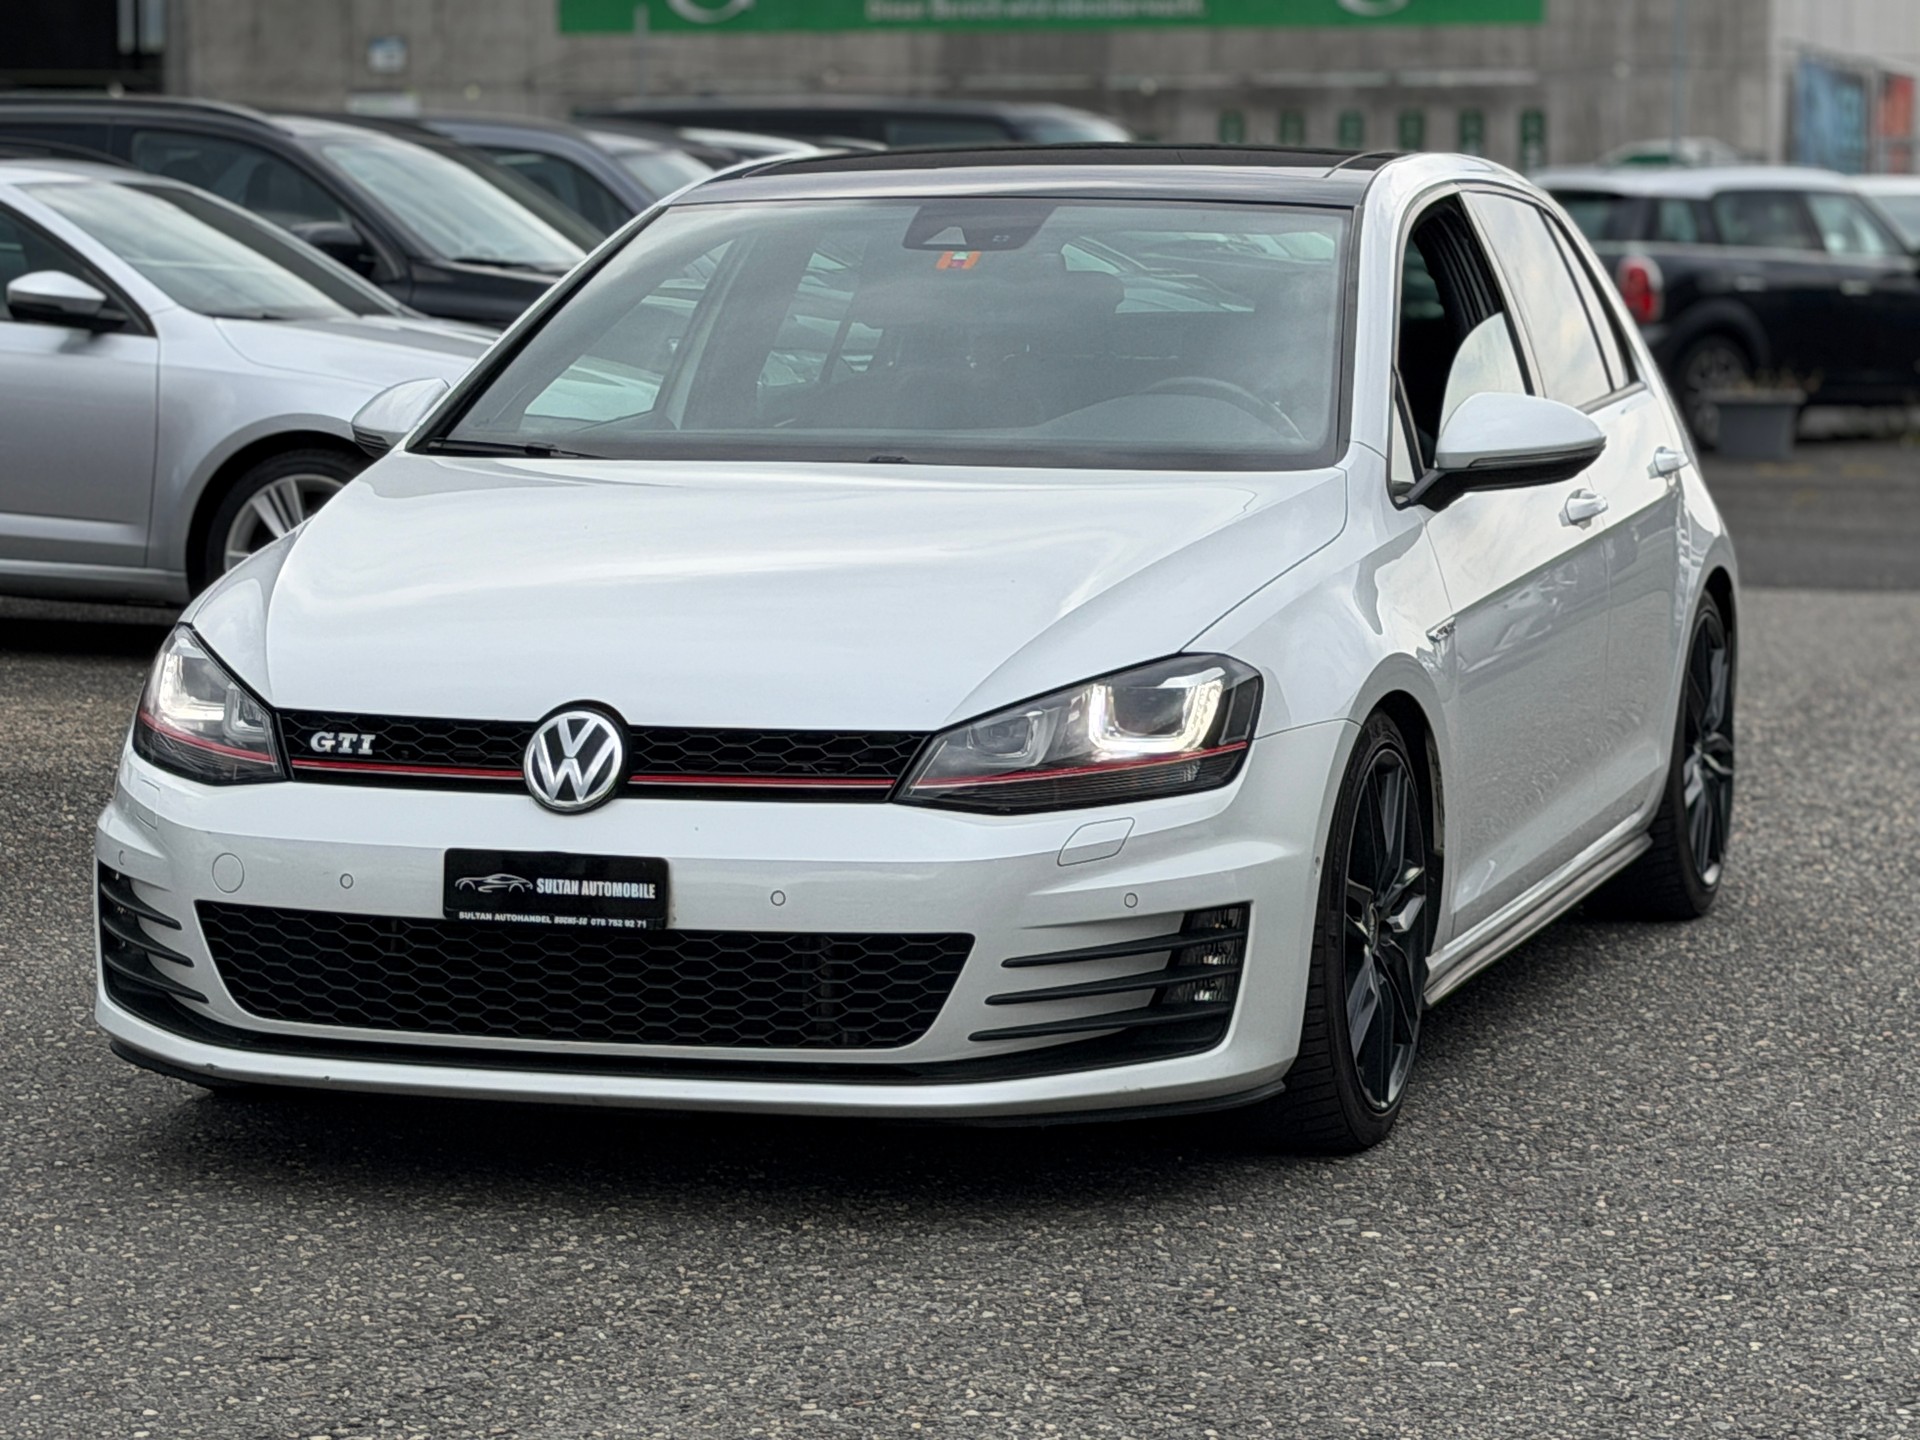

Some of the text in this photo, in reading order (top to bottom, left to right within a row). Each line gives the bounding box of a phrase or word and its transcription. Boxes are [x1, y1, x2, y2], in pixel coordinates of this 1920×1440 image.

[310, 731, 375, 755] GTI
[526, 712, 620, 806] VW
[536, 877, 656, 899] SULTAN AUTOMOBILE
[458, 911, 492, 921] SULTAN
[494, 913, 552, 924] AUTOHANDEL
[636, 919, 647, 929] 71
